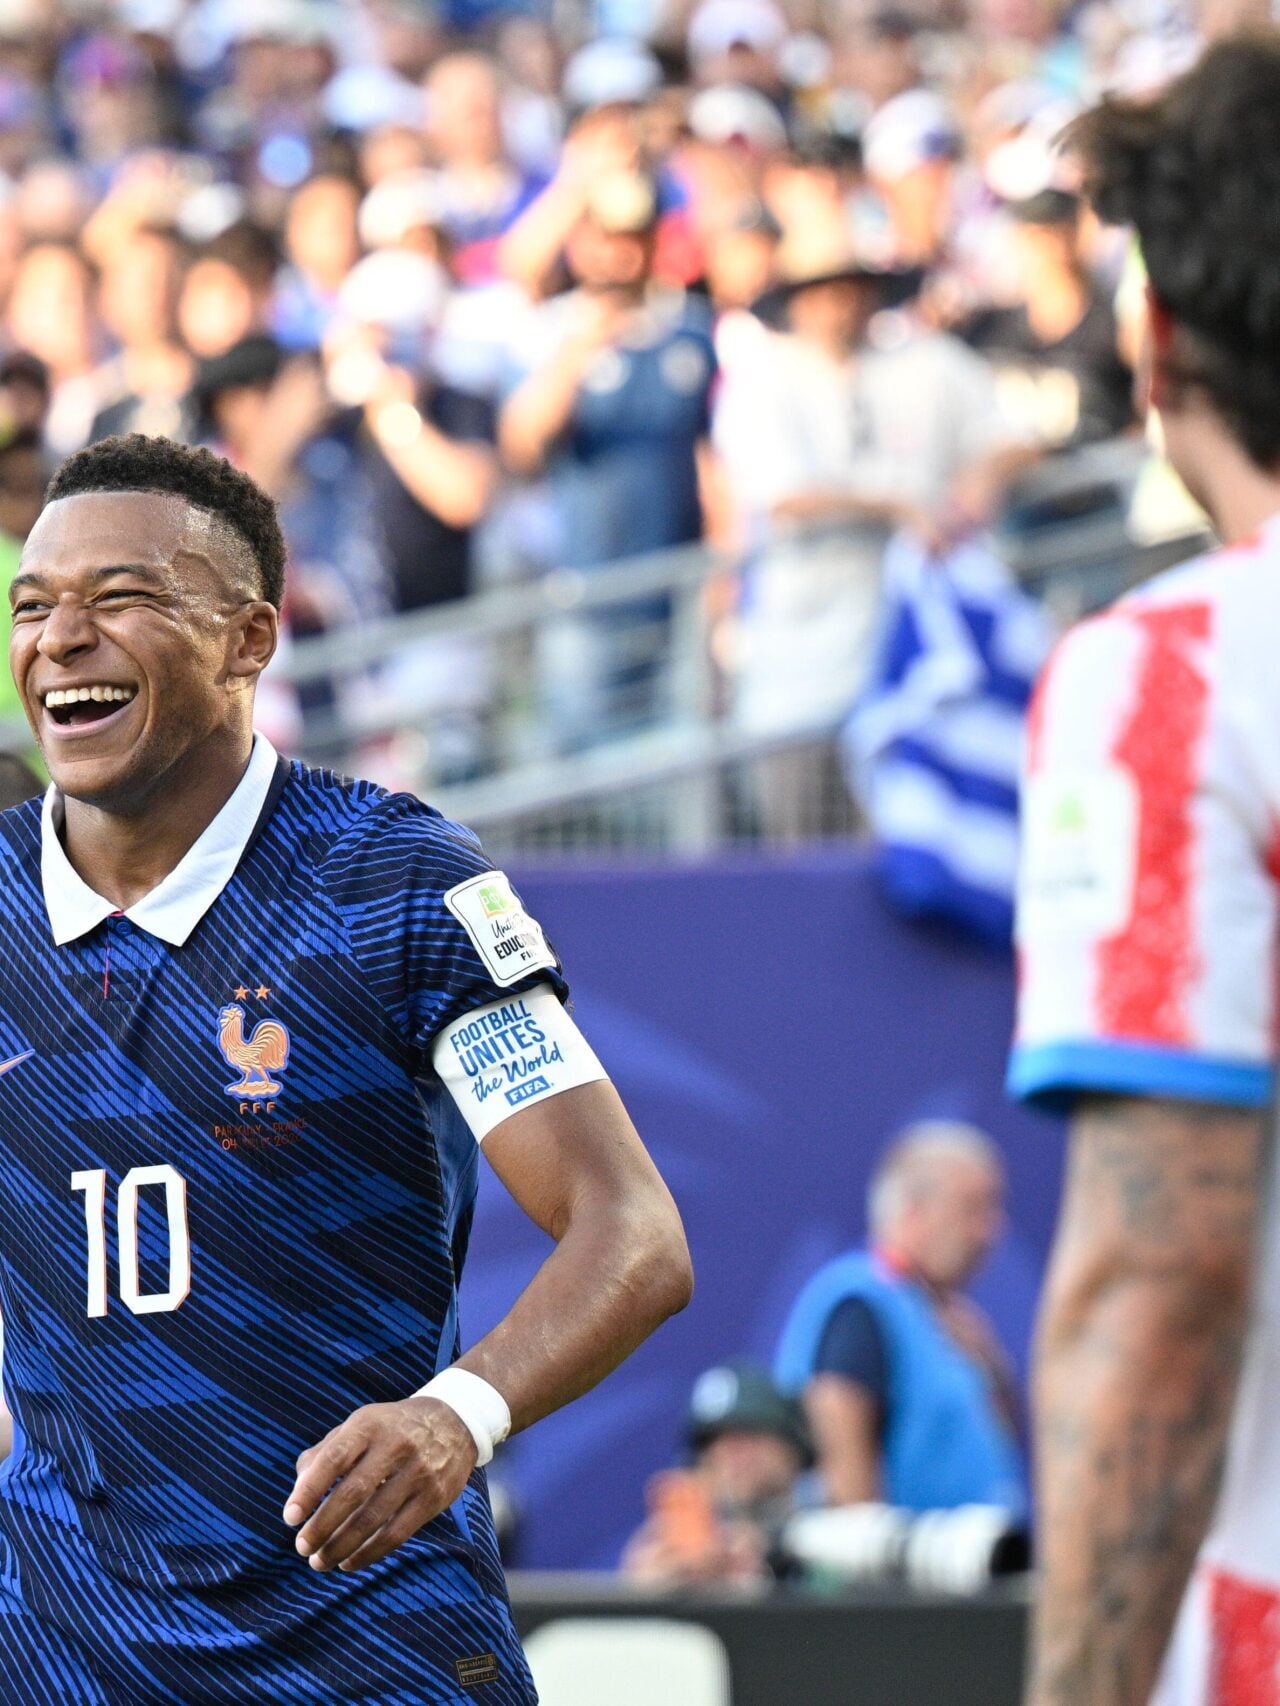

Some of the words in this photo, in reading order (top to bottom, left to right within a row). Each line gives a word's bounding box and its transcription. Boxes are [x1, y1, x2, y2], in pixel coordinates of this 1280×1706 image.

[519, 947, 536, 961] FI
[450, 1000, 531, 1053] FOOTBALL
[459, 1019, 545, 1077] UNITES
[472, 1076, 502, 1102] the
[501, 1041, 564, 1083] World
[507, 1078, 548, 1104] FIFA
[222, 1138, 237, 1151] 04
[71, 1164, 191, 1318] 10
